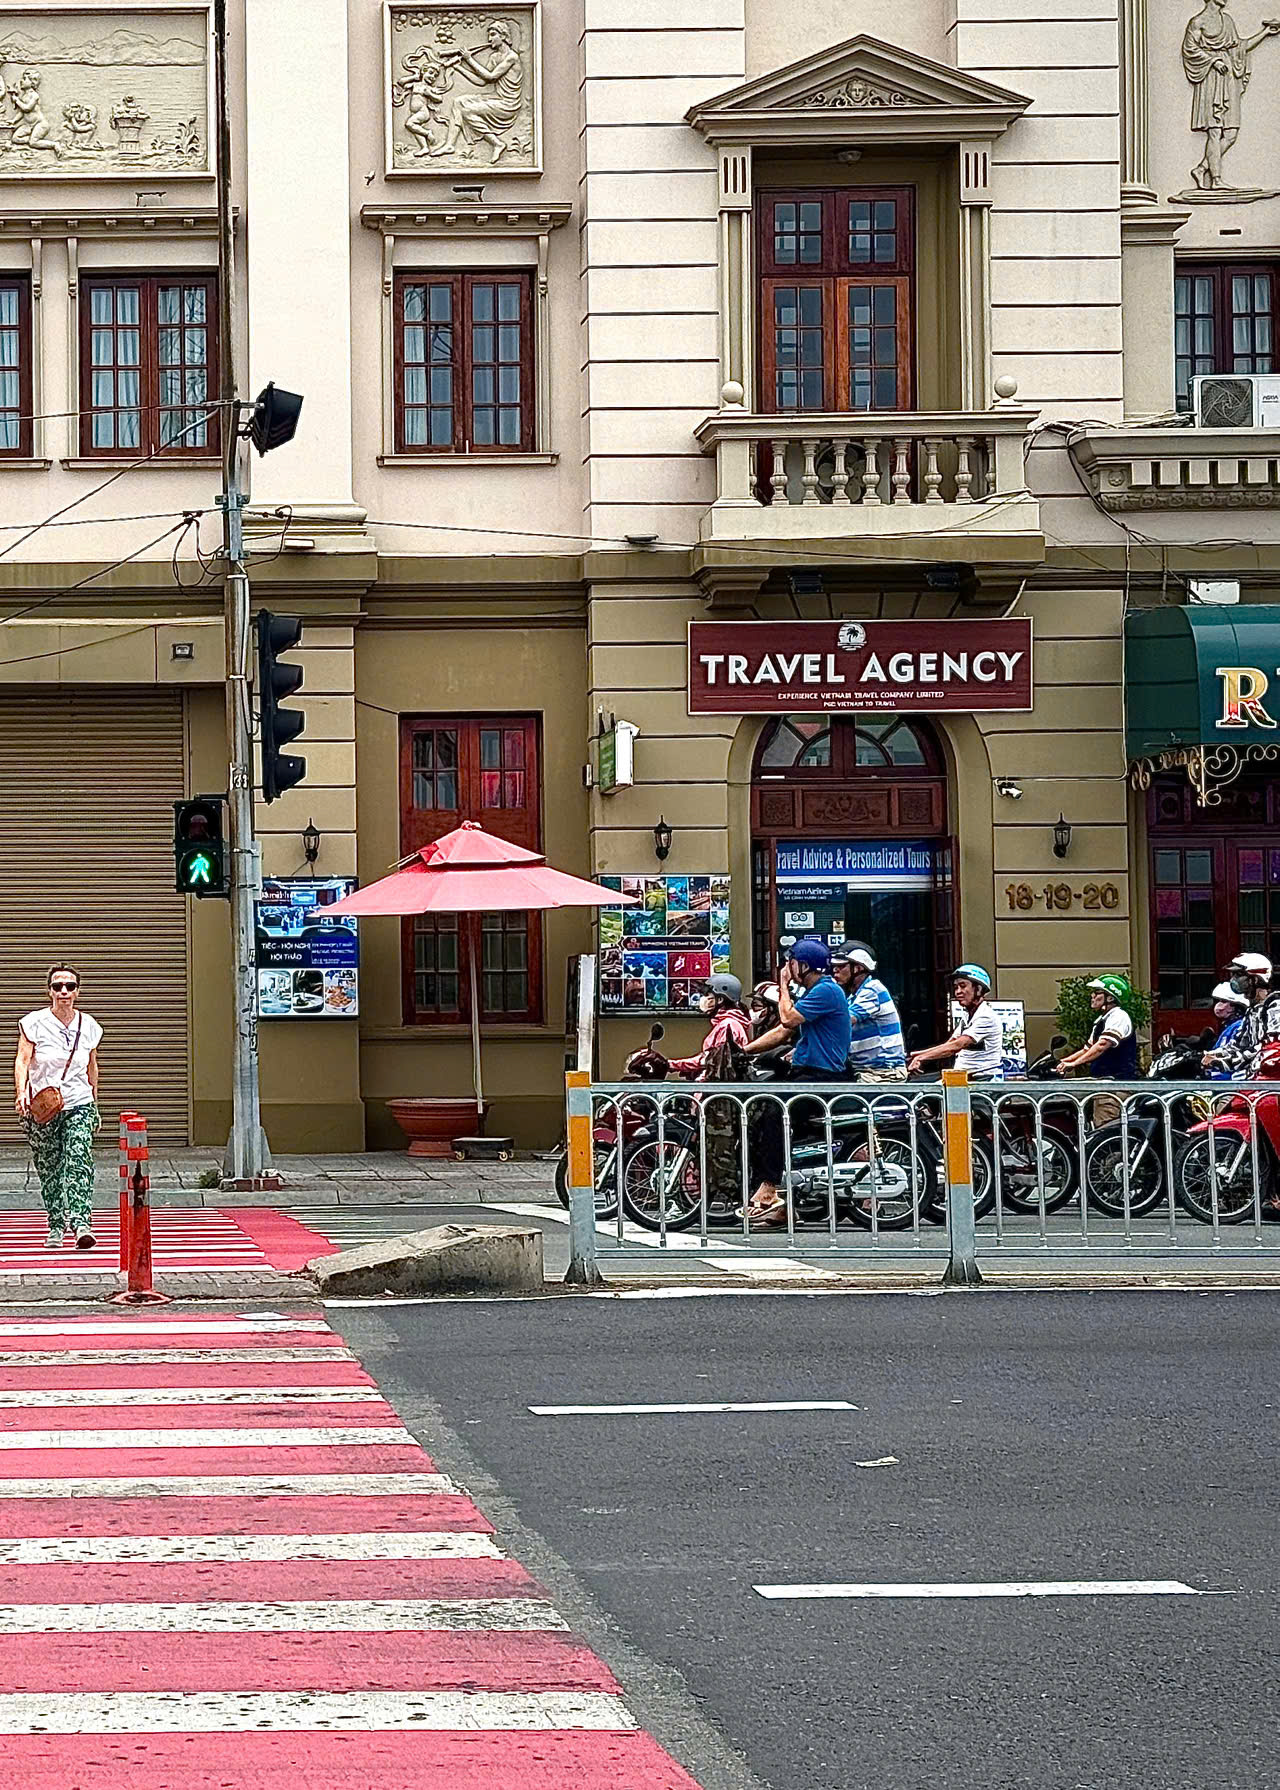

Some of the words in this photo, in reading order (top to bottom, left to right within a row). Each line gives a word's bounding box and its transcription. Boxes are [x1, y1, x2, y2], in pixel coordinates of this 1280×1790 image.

[699, 653, 845, 685] TRAVEL
[859, 651, 1024, 683] AGENCY
[854, 691, 879, 699] TRAVEL
[880, 691, 914, 699] COMPANY
[1215, 667, 1280, 729] R
[802, 848, 834, 870] Advice
[836, 849, 844, 870] &
[845, 847, 905, 869] Personalized
[906, 847, 931, 869] Tours
[1005, 882, 1120, 910] 18-19-20
